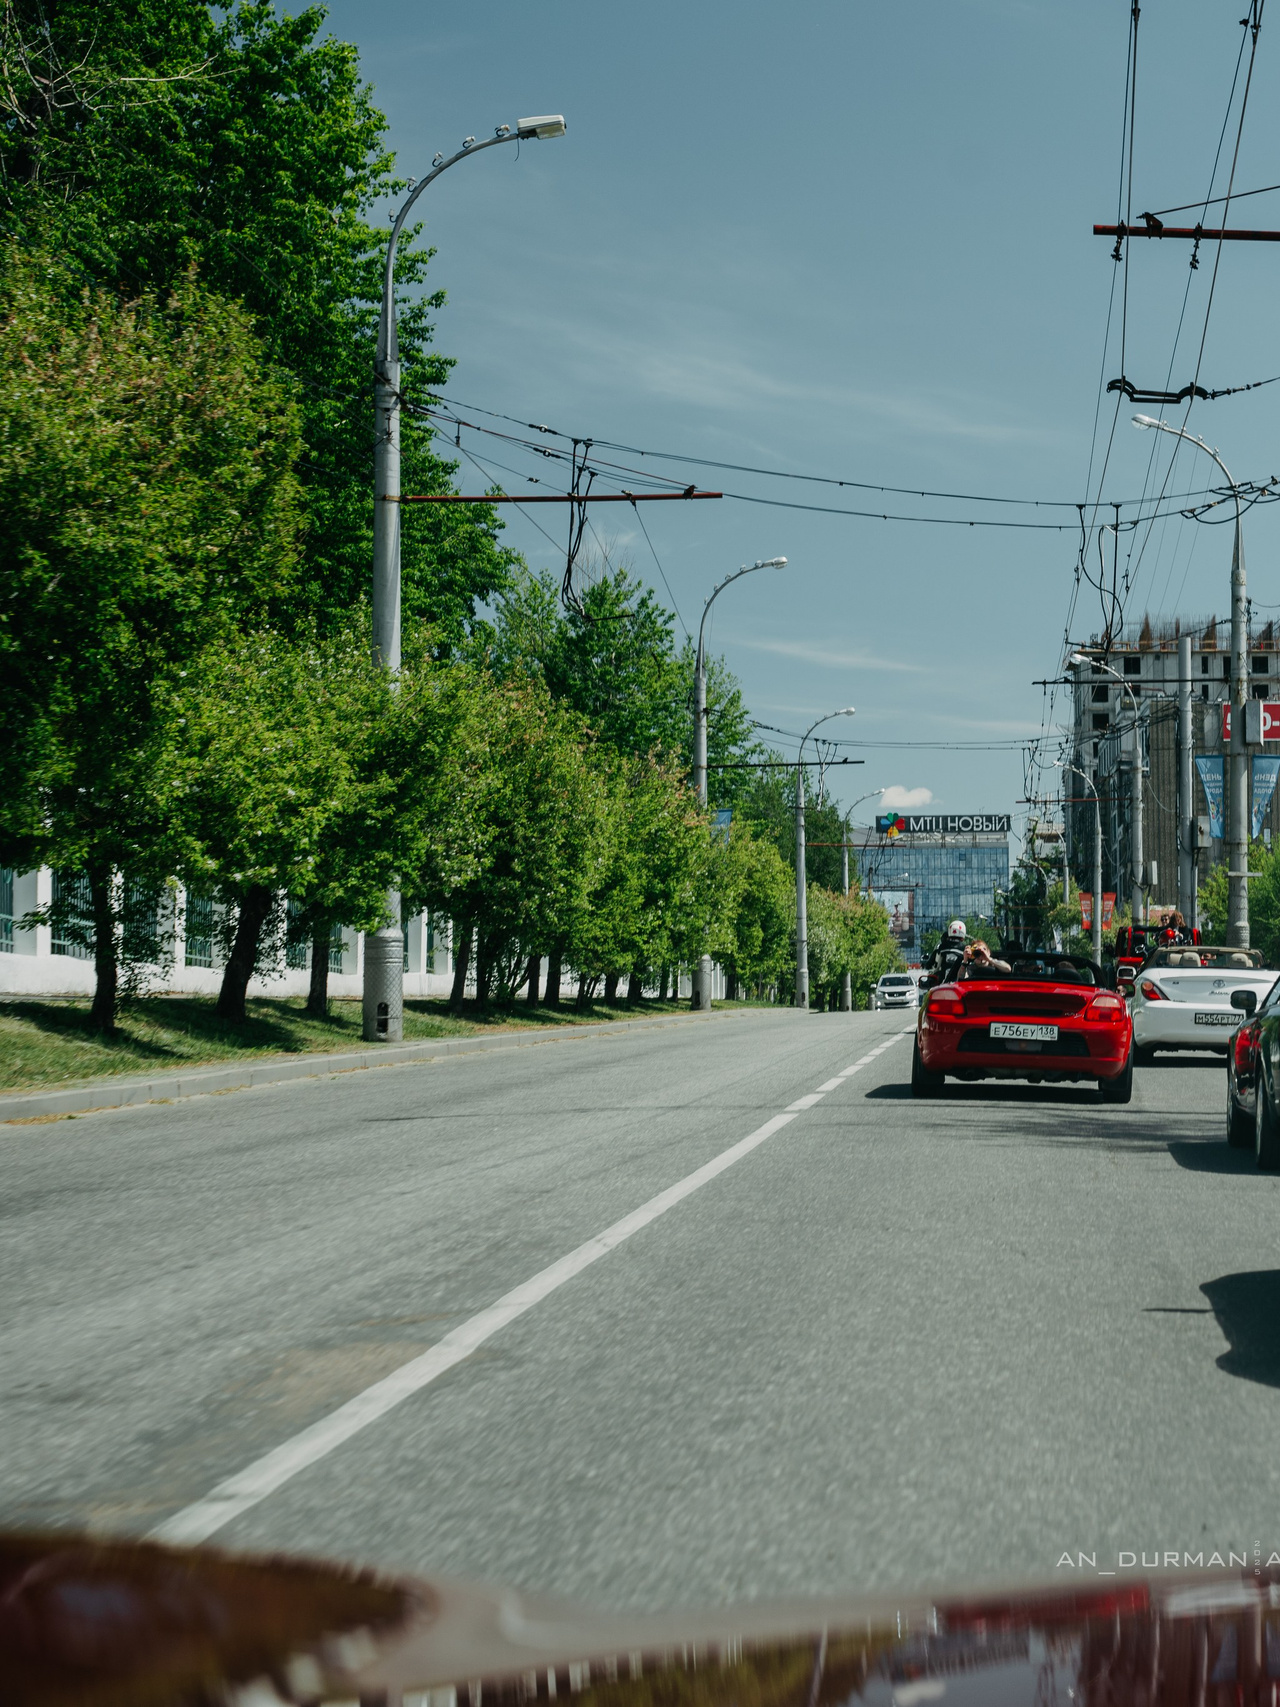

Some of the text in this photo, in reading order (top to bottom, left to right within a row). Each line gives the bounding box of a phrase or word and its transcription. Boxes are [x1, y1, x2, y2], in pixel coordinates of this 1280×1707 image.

[909, 815, 1007, 832] МТЦ НОВЫЙ
[993, 1025, 1055, 1038] Е756ЕУ 138
